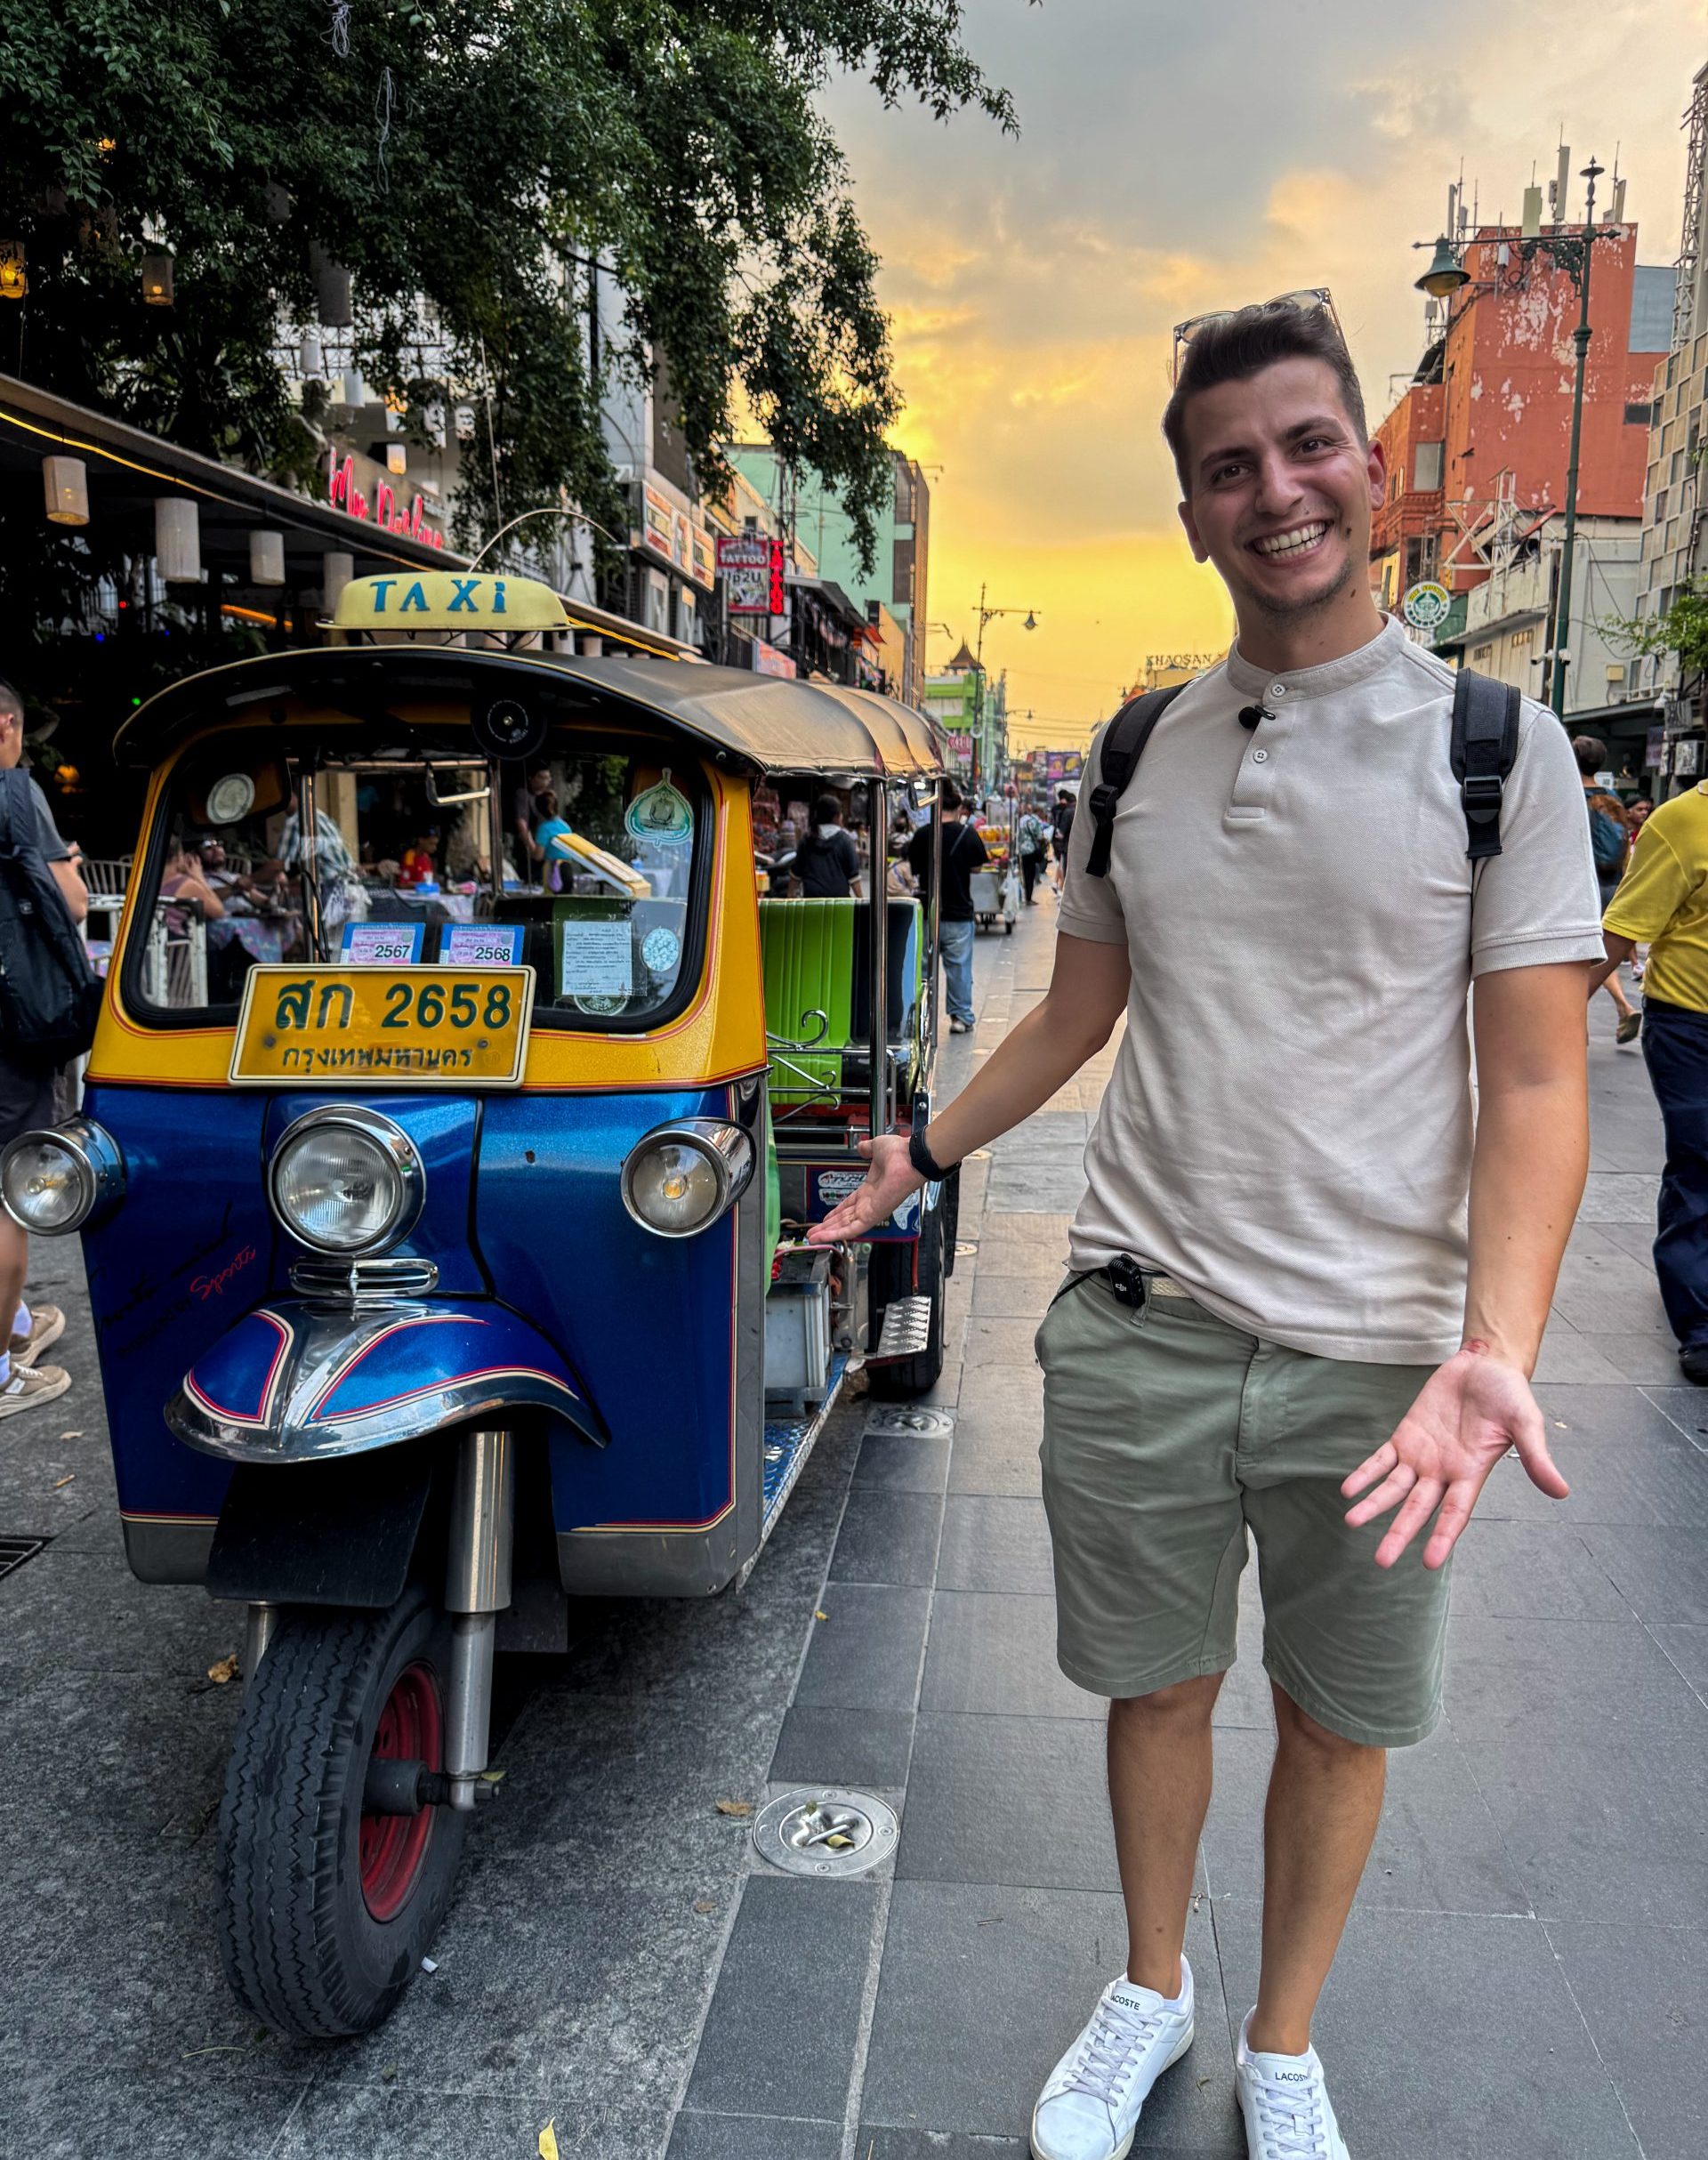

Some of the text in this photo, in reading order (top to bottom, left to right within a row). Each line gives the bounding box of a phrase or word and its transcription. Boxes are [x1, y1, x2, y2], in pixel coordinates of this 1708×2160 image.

[720, 554, 766, 565] TATTOO
[769, 540, 784, 615] TATTOO
[1146, 653, 1212, 666] KHAOSAN
[375, 945, 411, 958] 2567
[475, 947, 511, 962] 2568
[275, 979, 512, 1030] สก 2658
[282, 1046, 473, 1074] กรุงเทพมหานคร
[1110, 1995, 1141, 2011] ACOSTE
[1275, 2071, 1309, 2082] LACOST
